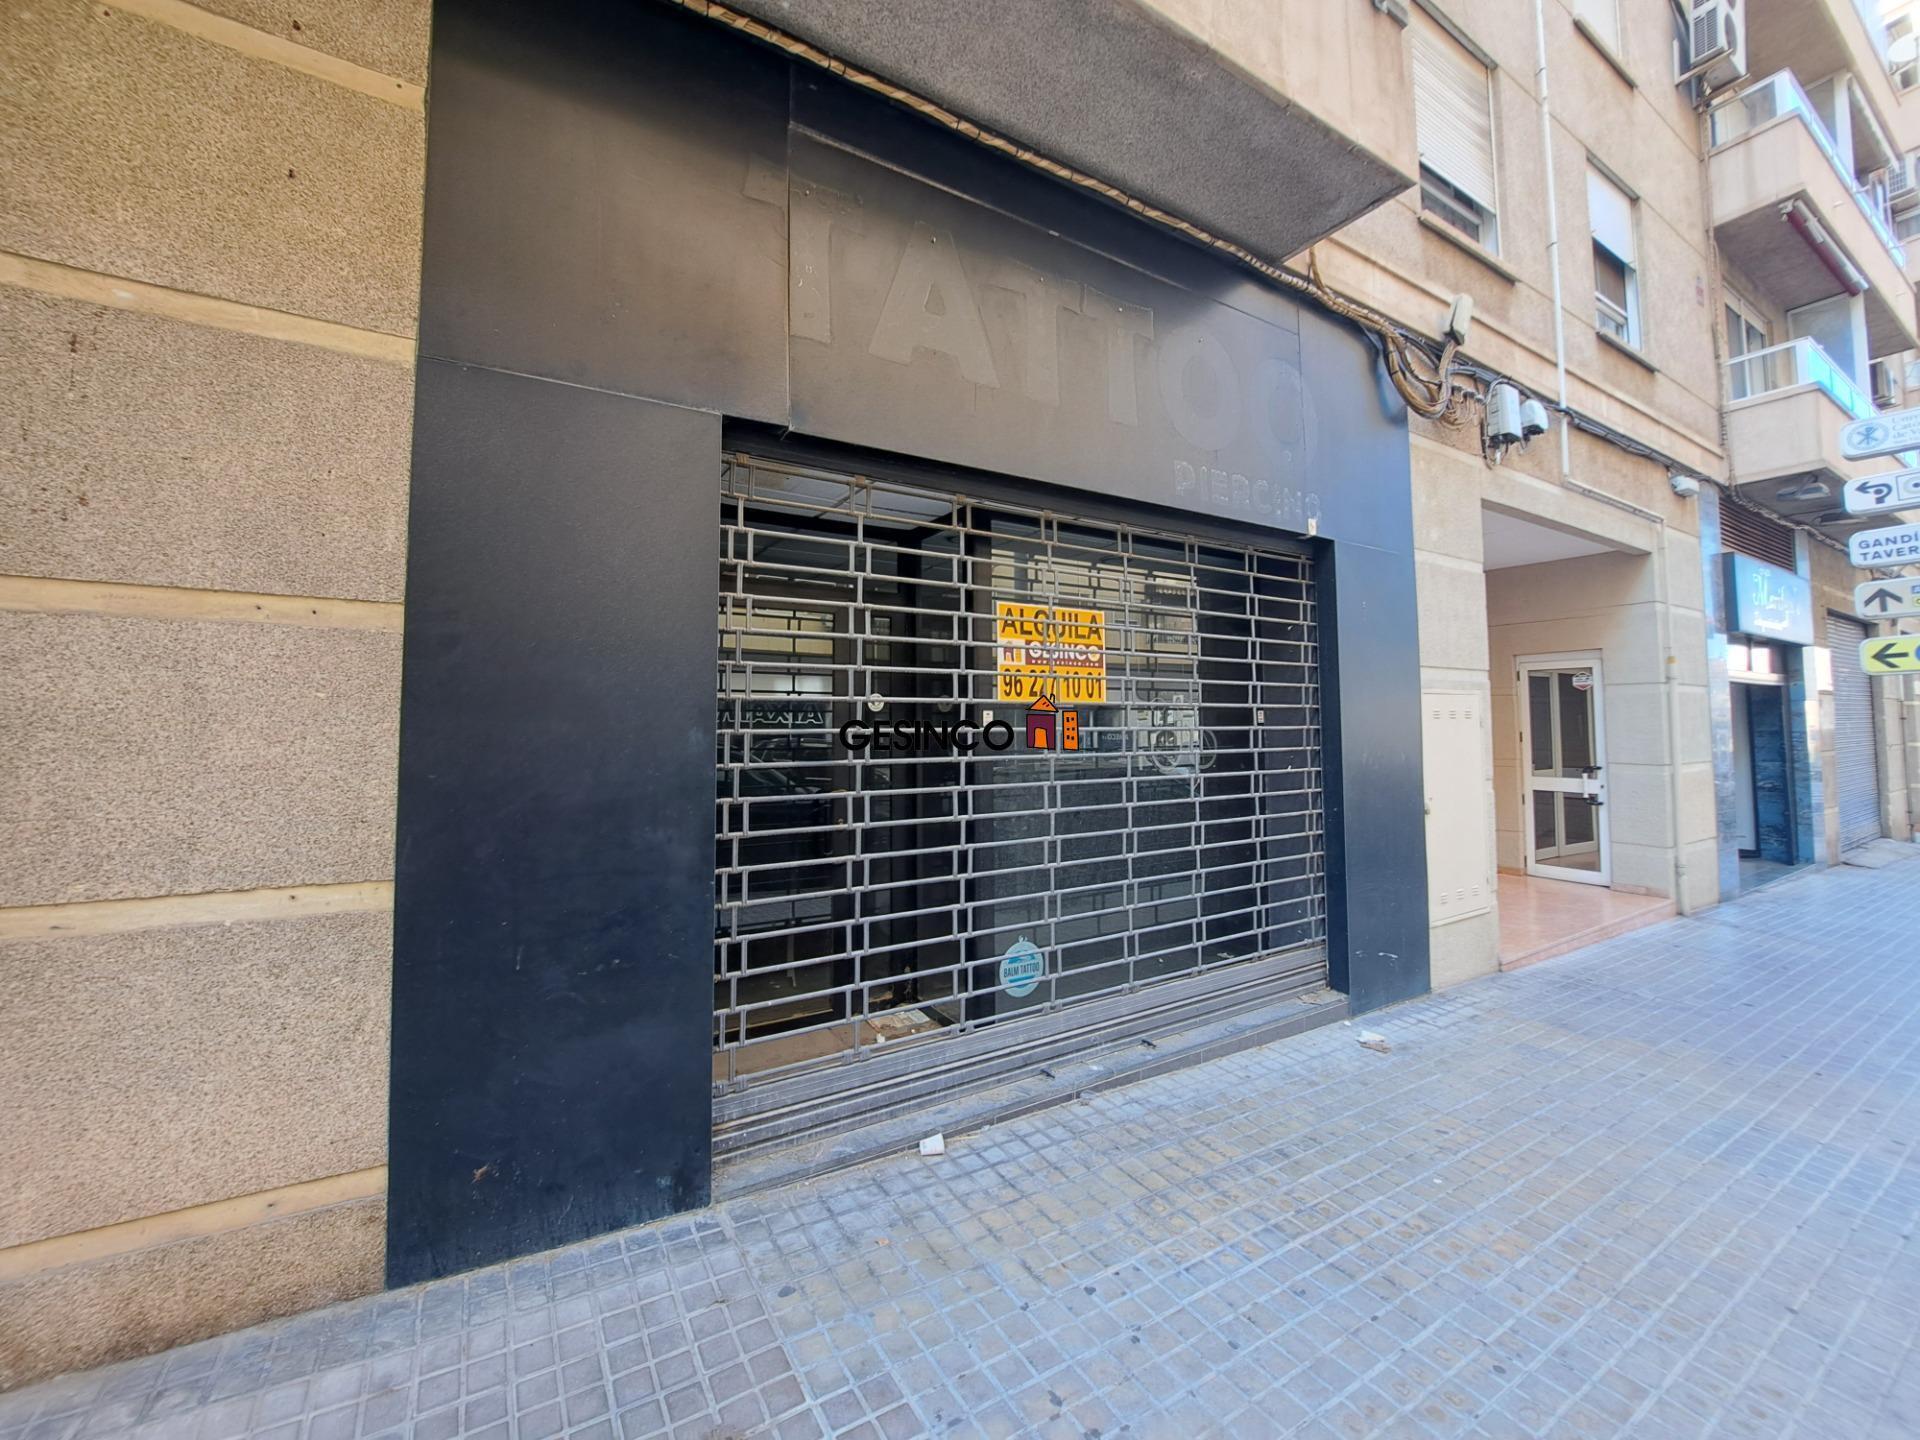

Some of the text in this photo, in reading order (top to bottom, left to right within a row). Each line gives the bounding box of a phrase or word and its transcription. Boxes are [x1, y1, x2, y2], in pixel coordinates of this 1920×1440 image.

[742, 152, 1320, 470] TATTOO
[1001, 608, 1102, 640] ALQUILA
[1003, 668, 1023, 697] 96
[1064, 671, 1081, 698] 10
[1086, 672, 1102, 699] 01
